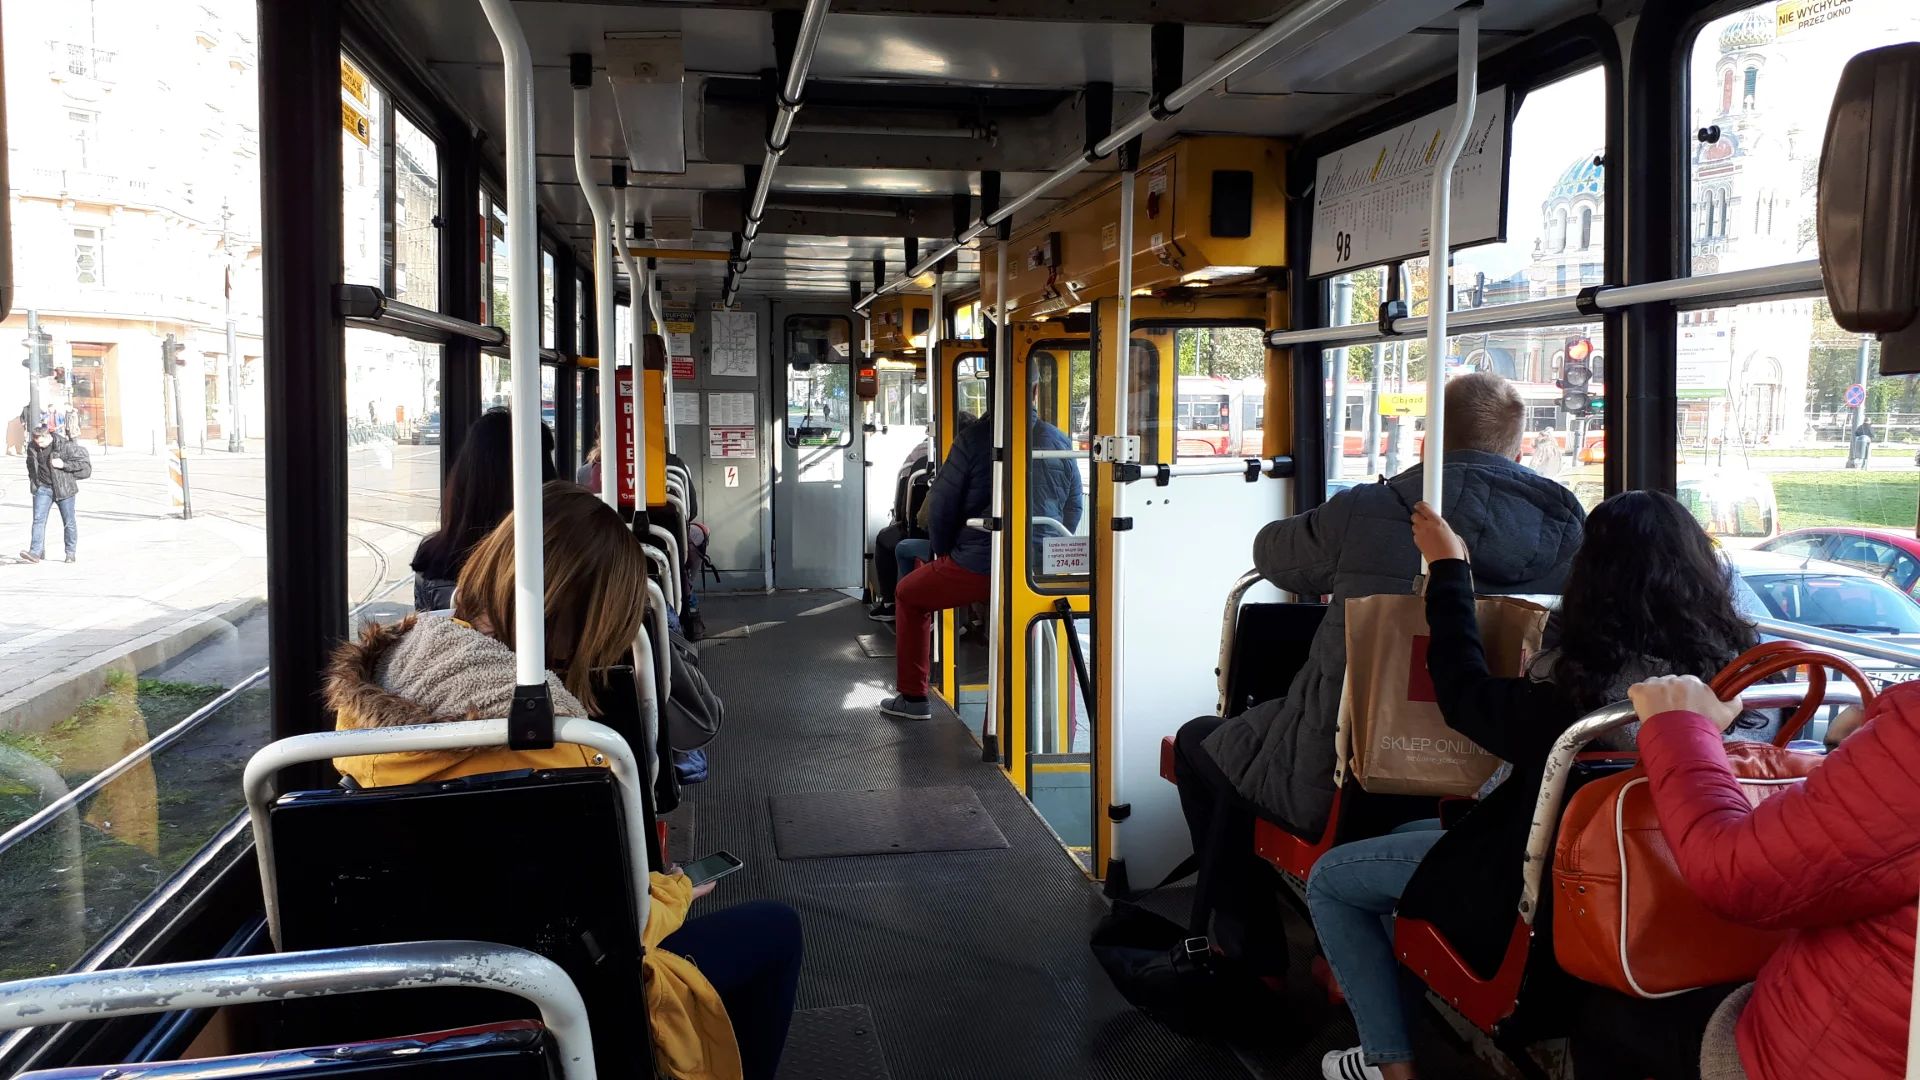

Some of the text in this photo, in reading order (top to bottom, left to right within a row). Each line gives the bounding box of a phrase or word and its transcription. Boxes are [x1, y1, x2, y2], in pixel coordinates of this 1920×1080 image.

[1779, 0, 1853, 26] NIE WYCHYLA
[1798, 6, 1851, 29] PRZEZ OKNO
[1336, 230, 1351, 263] 9B
[1392, 396, 1423, 404] Objazd
[623, 402, 635, 490] BILETY
[1056, 558, 1080, 567] 274,40
[1380, 735, 1431, 752] SKLEP
